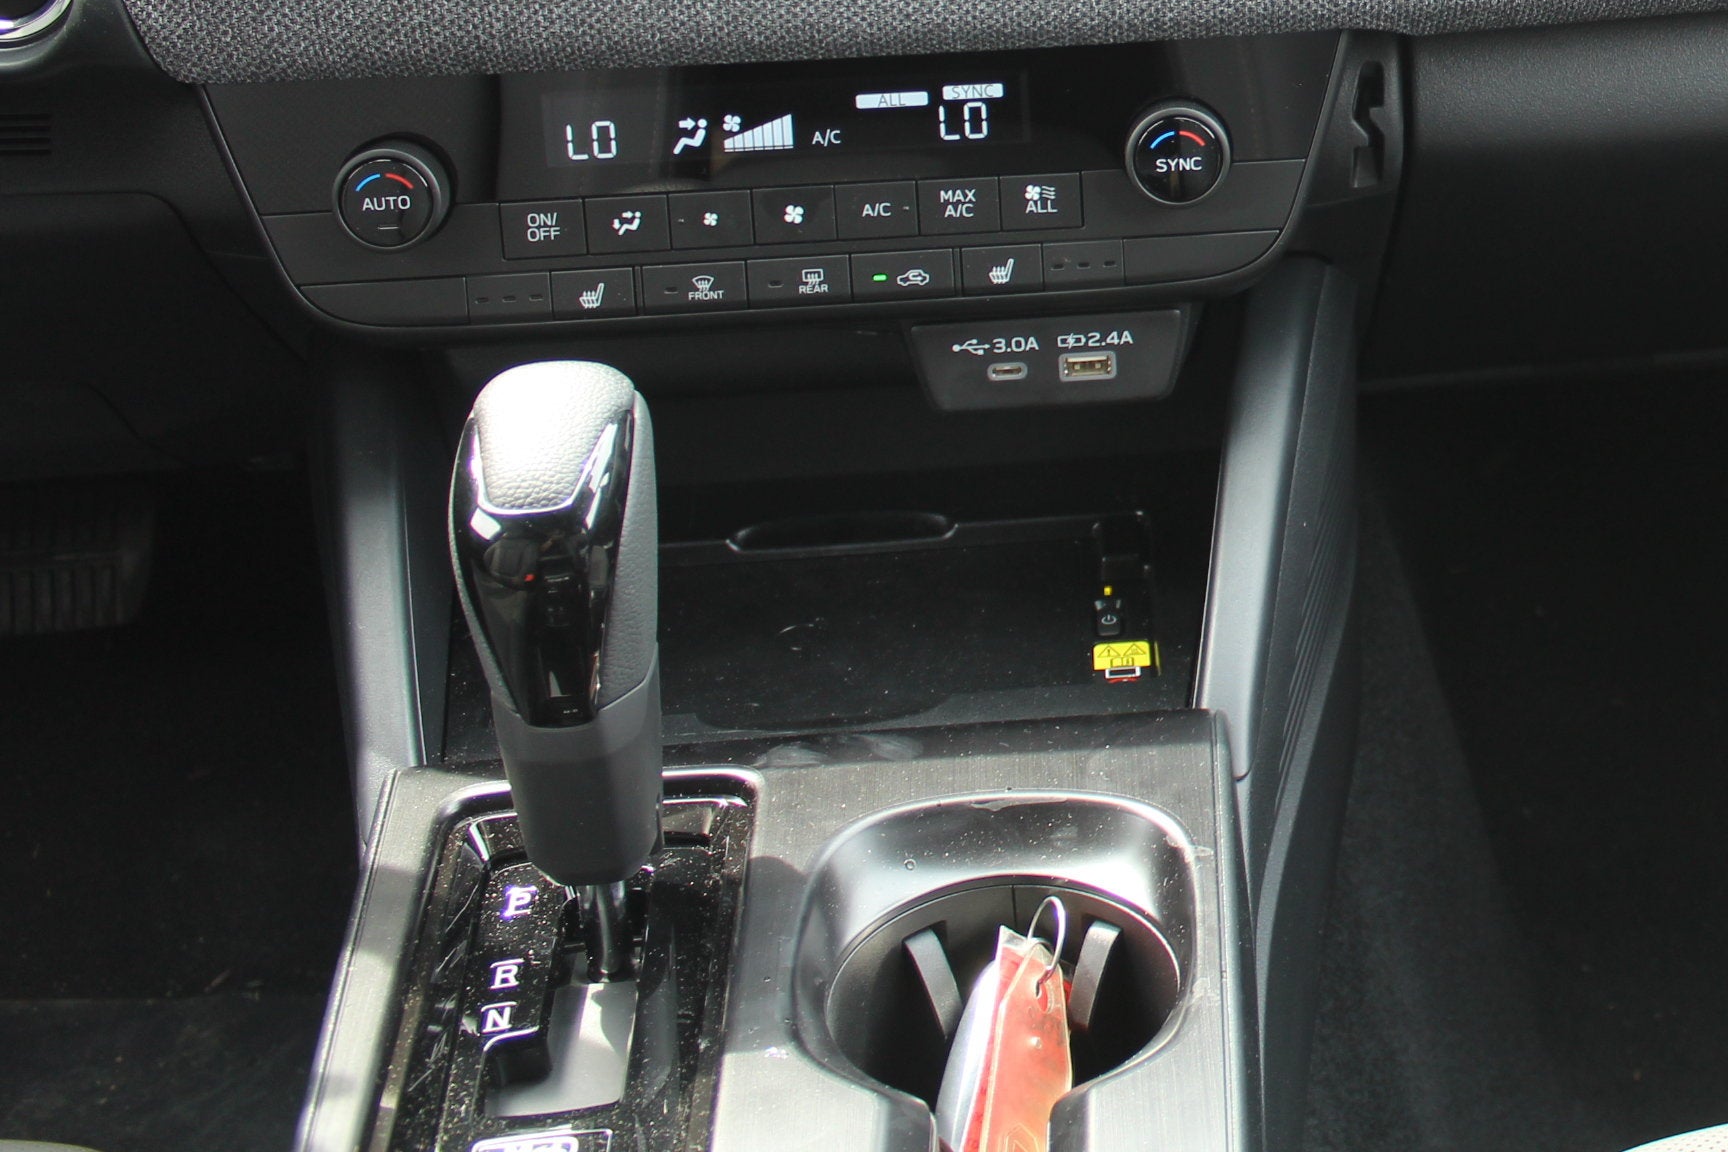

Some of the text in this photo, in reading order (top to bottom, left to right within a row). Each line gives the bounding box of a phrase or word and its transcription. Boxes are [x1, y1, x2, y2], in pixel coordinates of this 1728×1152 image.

[951, 84, 994, 99] SYNC
[877, 94, 907, 108] ALL
[939, 102, 988, 140] LO
[565, 120, 617, 160] LO
[812, 129, 841, 146] A/C
[1155, 156, 1203, 173] SYNC
[362, 195, 411, 211] AUTO
[940, 188, 976, 203] MAX
[862, 202, 892, 218] A/C
[944, 203, 974, 219] A/C
[1025, 200, 1058, 214] ALL
[527, 212, 558, 228] ON/
[527, 226, 561, 242] OFF
[688, 289, 724, 301] FRONT
[799, 283, 829, 295] REAR
[992, 336, 1039, 353] 3.0A
[1088, 330, 1134, 347] 2.4A
[504, 888, 532, 916] P
[492, 964, 519, 988] R
[484, 1006, 512, 1030] N
